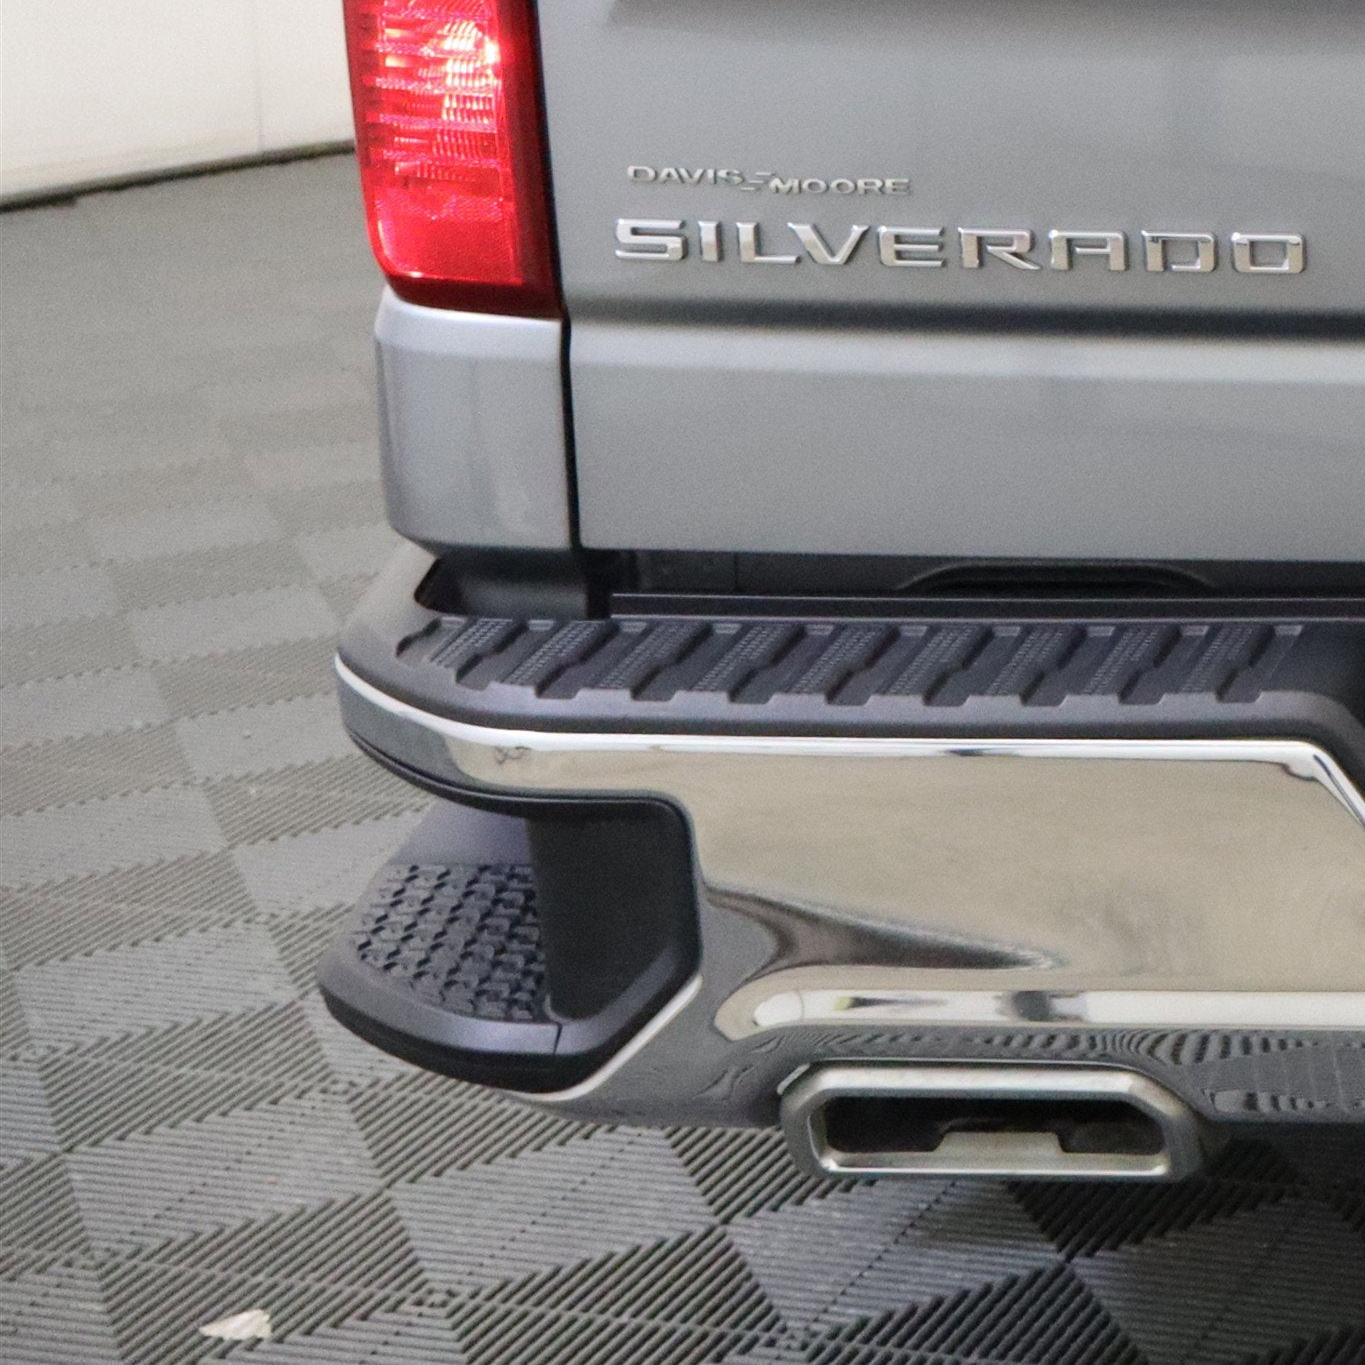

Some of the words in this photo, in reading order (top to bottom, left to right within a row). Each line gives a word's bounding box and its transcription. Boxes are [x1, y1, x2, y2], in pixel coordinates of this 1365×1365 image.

[627, 165, 745, 186] DAVIS
[768, 177, 910, 195] MOORE
[615, 218, 1306, 274] SILVERADO
